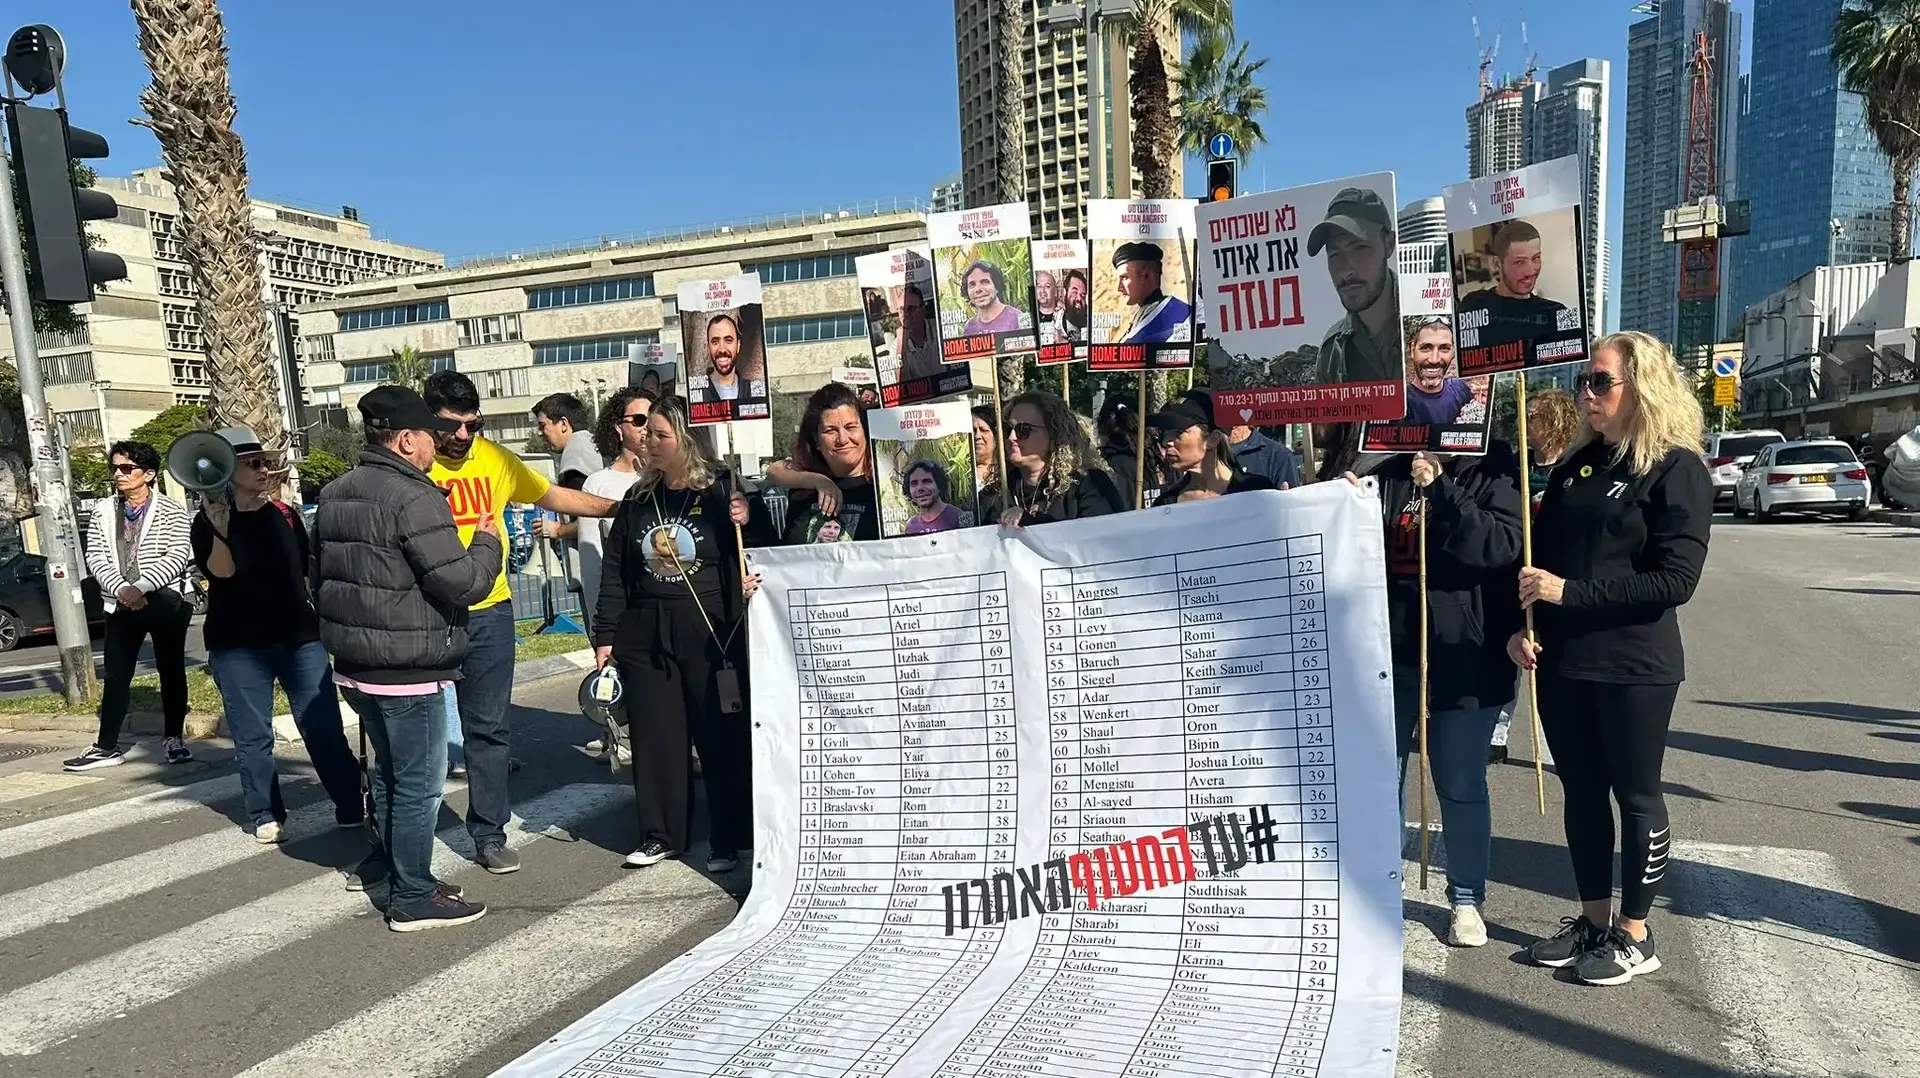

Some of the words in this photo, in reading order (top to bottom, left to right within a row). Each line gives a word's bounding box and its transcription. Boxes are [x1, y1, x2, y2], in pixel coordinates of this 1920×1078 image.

[1494, 181, 1501, 192] חן
[1503, 176, 1519, 189] איתי
[1491, 193, 1504, 205] ITAY
[1506, 188, 1524, 201] CHEN
[1502, 201, 1514, 215] (19)
[958, 223, 971, 232] OFER
[972, 220, 999, 229] KALDERON
[1121, 214, 1141, 223] MATAN
[1142, 214, 1168, 223] ANGREST
[1275, 204, 1297, 233] לא
[987, 228, 1000, 236] 54
[1139, 225, 1150, 234] (21)
[1209, 211, 1269, 243] שוכחים
[1213, 243, 1260, 278] איתי
[1267, 237, 1299, 272] את
[1422, 289, 1440, 299] TAMIR
[1218, 275, 1304, 333] בעזה
[1432, 299, 1446, 310] (38)
[941, 310, 966, 324] BRING
[1092, 312, 1121, 328] BRING
[1459, 308, 1489, 330] BRING
[942, 324, 959, 339] HIM
[1092, 328, 1111, 343] HIM
[1460, 329, 1480, 348] HIM
[943, 338, 969, 356] HOME
[969, 335, 996, 353] NOW!
[1091, 346, 1118, 362] HOME
[1120, 345, 1146, 361] NOW!
[1461, 347, 1490, 368] HOME
[1492, 339, 1524, 363] NOW!
[1536, 347, 1561, 360] FAMILIES
[1562, 344, 1582, 356] FORUM
[878, 355, 904, 372] BRING
[688, 375, 709, 389] BRING
[690, 390, 703, 403] HIM
[1302, 389, 1316, 401] נפל
[1340, 388, 1349, 401] חן
[1351, 387, 1371, 398] איתי
[691, 403, 710, 417] HOME
[711, 401, 731, 416] NOW!
[900, 421, 913, 430] OFER
[915, 419, 941, 428] KALDERON
[1367, 426, 1400, 443] HOME
[1401, 424, 1429, 443] NOW!
[437, 477, 491, 516] OW
[882, 508, 908, 520] BRING
[884, 521, 900, 537] HIM
[1046, 590, 1058, 601] 51
[1077, 586, 1119, 602] Angrest
[1181, 574, 1217, 587] Matan
[1298, 560, 1313, 572] 22
[808, 609, 849, 619] Yehoud
[893, 602, 922, 614] Arbel
[986, 595, 999, 606] 29
[1048, 624, 1062, 635] 53
[1078, 622, 1107, 636] Levy
[1183, 610, 1223, 623] Naama
[1299, 599, 1315, 610] 20
[799, 643, 805, 652] 3
[813, 641, 842, 652] Shtivi
[896, 636, 919, 647] Idan
[988, 629, 1002, 640] 29
[804, 674, 809, 684] 5
[817, 672, 866, 684] Weinstein
[899, 669, 920, 679] Judi
[991, 663, 1003, 674] 71
[1051, 676, 1065, 687] 56
[1081, 673, 1116, 688] Siegel
[1186, 665, 1216, 678] Keith
[1220, 661, 1264, 675] Samuel
[1302, 656, 1318, 667] 65
[807, 706, 813, 715] 7
[822, 705, 875, 718] Zangauker
[902, 702, 931, 712] Matan
[993, 697, 1007, 708] 25
[1053, 711, 1067, 722] 58
[1082, 708, 1130, 720] Wenkert
[1187, 702, 1220, 714] Omer
[1304, 694, 1320, 706] 23
[805, 754, 817, 764] 10
[824, 753, 863, 764] Yaakov
[904, 752, 925, 762] Yair
[995, 749, 1009, 759] 60
[1054, 763, 1068, 774] 61
[1084, 760, 1120, 774] Mollel
[1189, 755, 1228, 769] Joshua
[1232, 755, 1263, 766] Loitu
[1308, 752, 1324, 763] 22
[805, 787, 817, 796] 12
[823, 785, 876, 796] Shem-Tov
[903, 785, 931, 795] Omer
[996, 783, 1009, 793] 22
[804, 803, 817, 812] 13
[823, 801, 874, 812] Braslavski
[903, 801, 927, 811] Rom
[996, 800, 1009, 810] 21
[1054, 797, 1068, 808] 63
[1084, 796, 1132, 810] Al-sayed
[1190, 793, 1234, 805] Hisham
[1310, 789, 1326, 801] 36
[804, 851, 815, 861] 16
[821, 851, 842, 861] Mor
[900, 850, 926, 861] Eitan
[930, 850, 977, 861] Abraham
[993, 850, 1007, 861] 24
[799, 883, 811, 892] 18
[817, 883, 879, 893] Steinbrecher
[895, 883, 928, 893] Doron
[1188, 884, 1248, 896] Sudthisak
[786, 910, 801, 919] 20
[807, 912, 838, 920] Moses
[887, 913, 912, 923] Gadi
[1045, 917, 1059, 928] 70
[1074, 917, 1119, 930] Sharabi
[1186, 920, 1220, 933] Yossi
[1311, 923, 1328, 935] 53
[1032, 959, 1047, 967] 73
[1063, 961, 1119, 974] Kalderon
[1178, 970, 1208, 981] Ofer
[1308, 977, 1326, 989] 54
